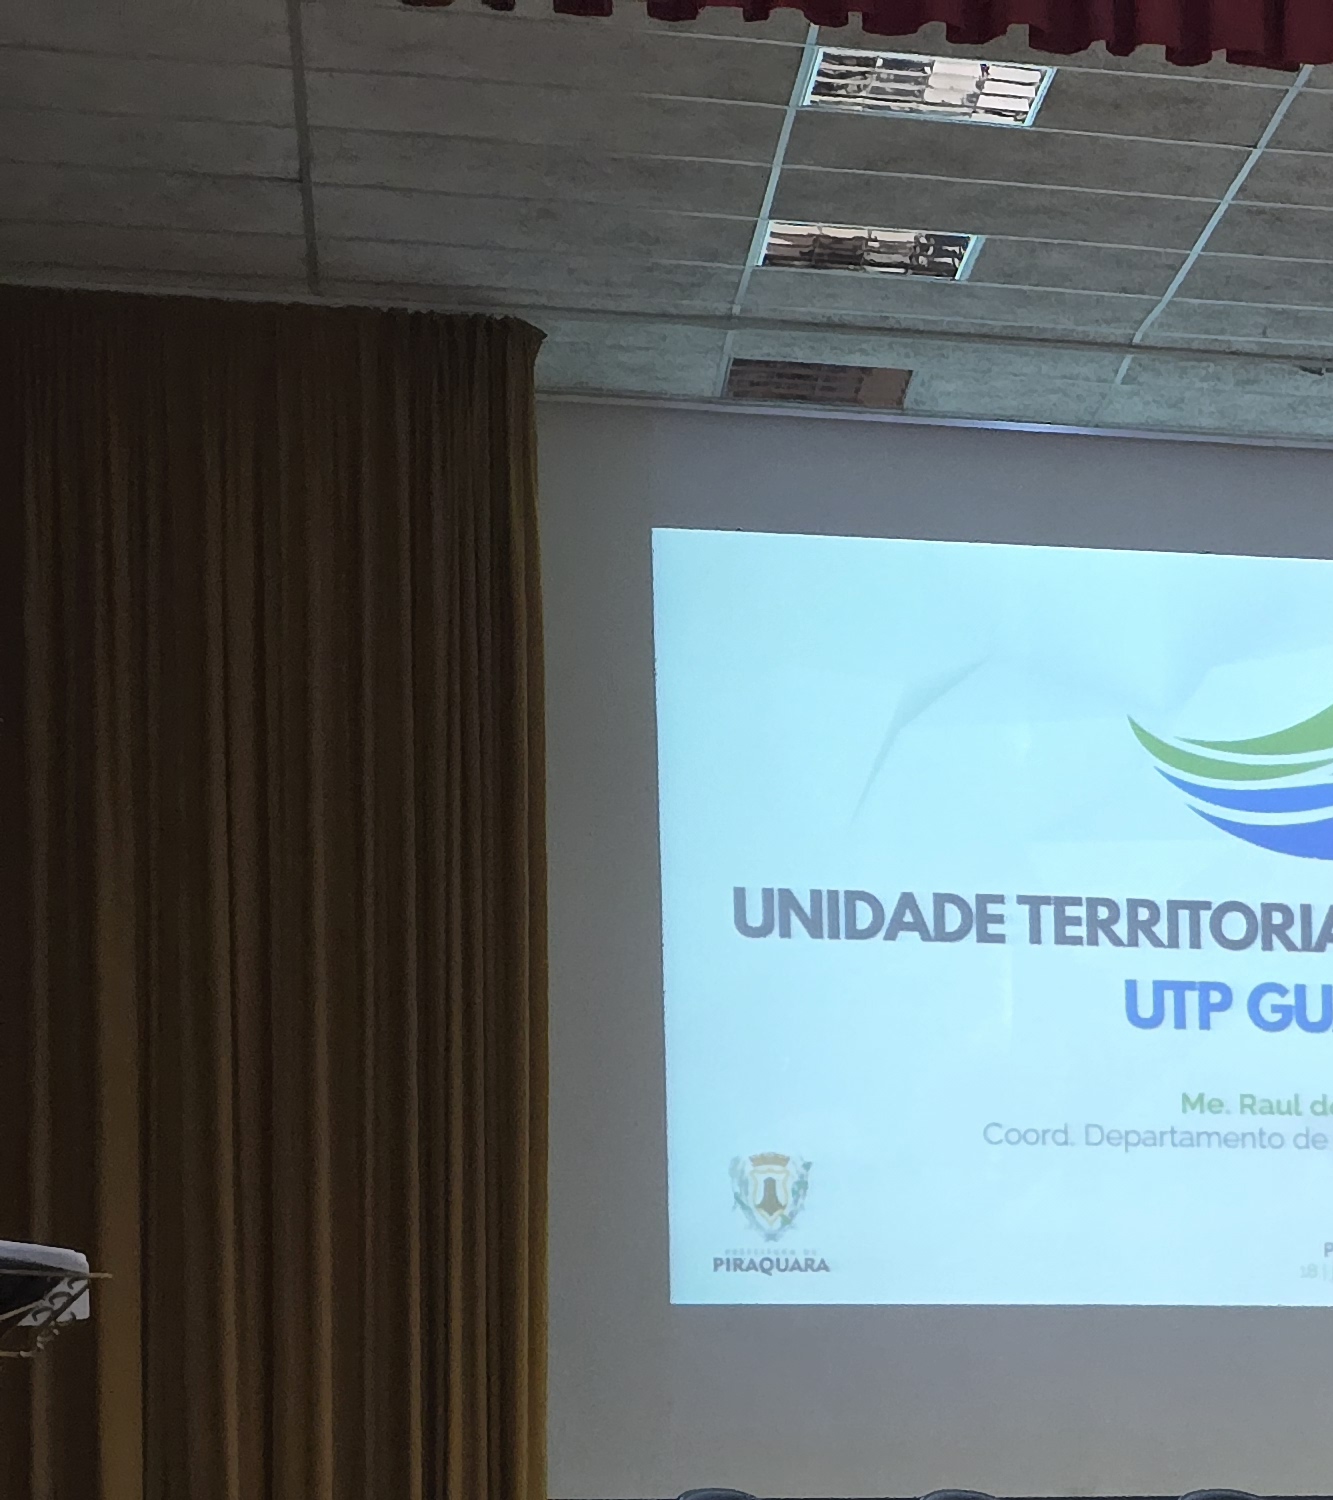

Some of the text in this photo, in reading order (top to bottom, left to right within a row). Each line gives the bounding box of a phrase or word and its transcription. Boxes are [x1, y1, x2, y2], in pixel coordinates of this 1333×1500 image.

[733, 886, 1006, 944] UNIDADE
[1124, 979, 1233, 1031] UTP
[1181, 1092, 1231, 1115] Me.
[1239, 1093, 1302, 1116] Raul
[983, 1122, 1076, 1147] Coord.
[1084, 1124, 1284, 1153] Departamento
[1292, 1128, 1329, 1150] de
[713, 1257, 830, 1276] PIRAQUARA
